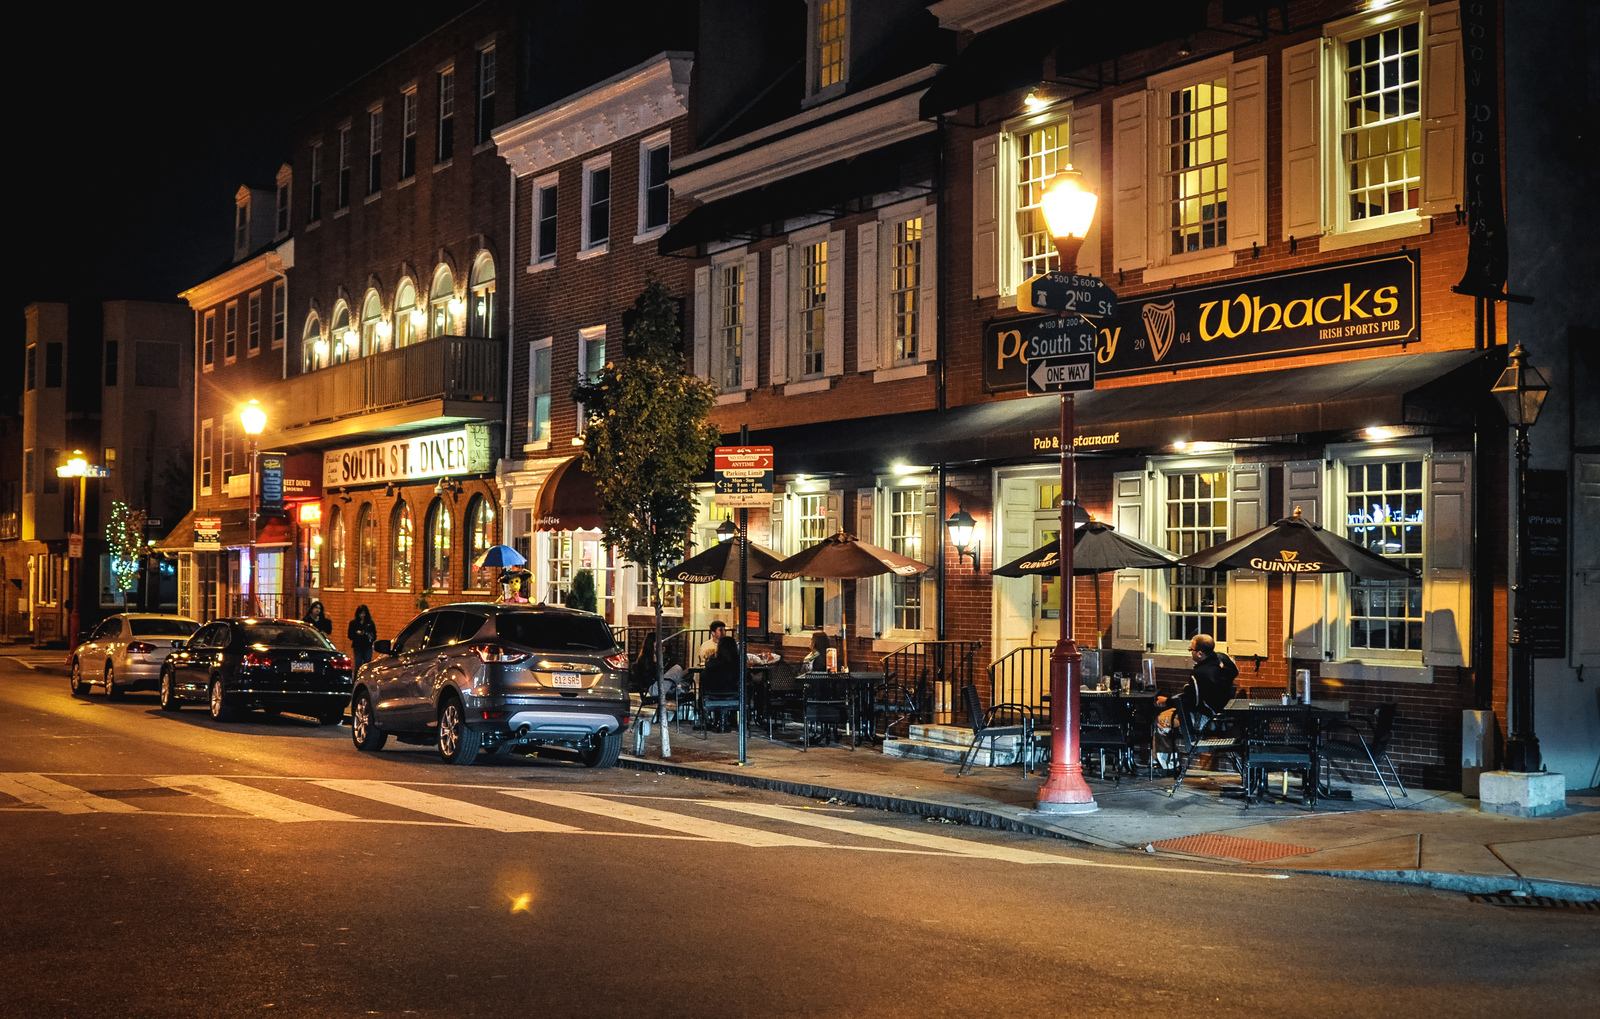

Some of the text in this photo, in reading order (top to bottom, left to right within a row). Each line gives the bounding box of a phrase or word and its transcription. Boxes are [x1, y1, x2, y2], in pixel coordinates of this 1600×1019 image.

[1054, 275, 1096, 288] 500 S 600
[1065, 290, 1112, 315] 2ND St
[1199, 282, 1399, 342] Whacks
[1057, 318, 1065, 328] W
[1319, 319, 1401, 340] IRISH SPORTS PUB
[1031, 333, 1070, 356] South
[1080, 333, 1092, 352] St
[1134, 332, 1191, 350] 20 04
[1046, 364, 1087, 382] ONE WAY
[1033, 432, 1120, 450] Pub & staurant
[342, 446, 386, 481] SOUTH
[390, 443, 413, 475] ST.
[420, 436, 466, 473] DINER
[263, 470, 281, 501] FOOD
[1249, 557, 1322, 572] GUINNESS
[677, 571, 717, 582] GUINNESS
